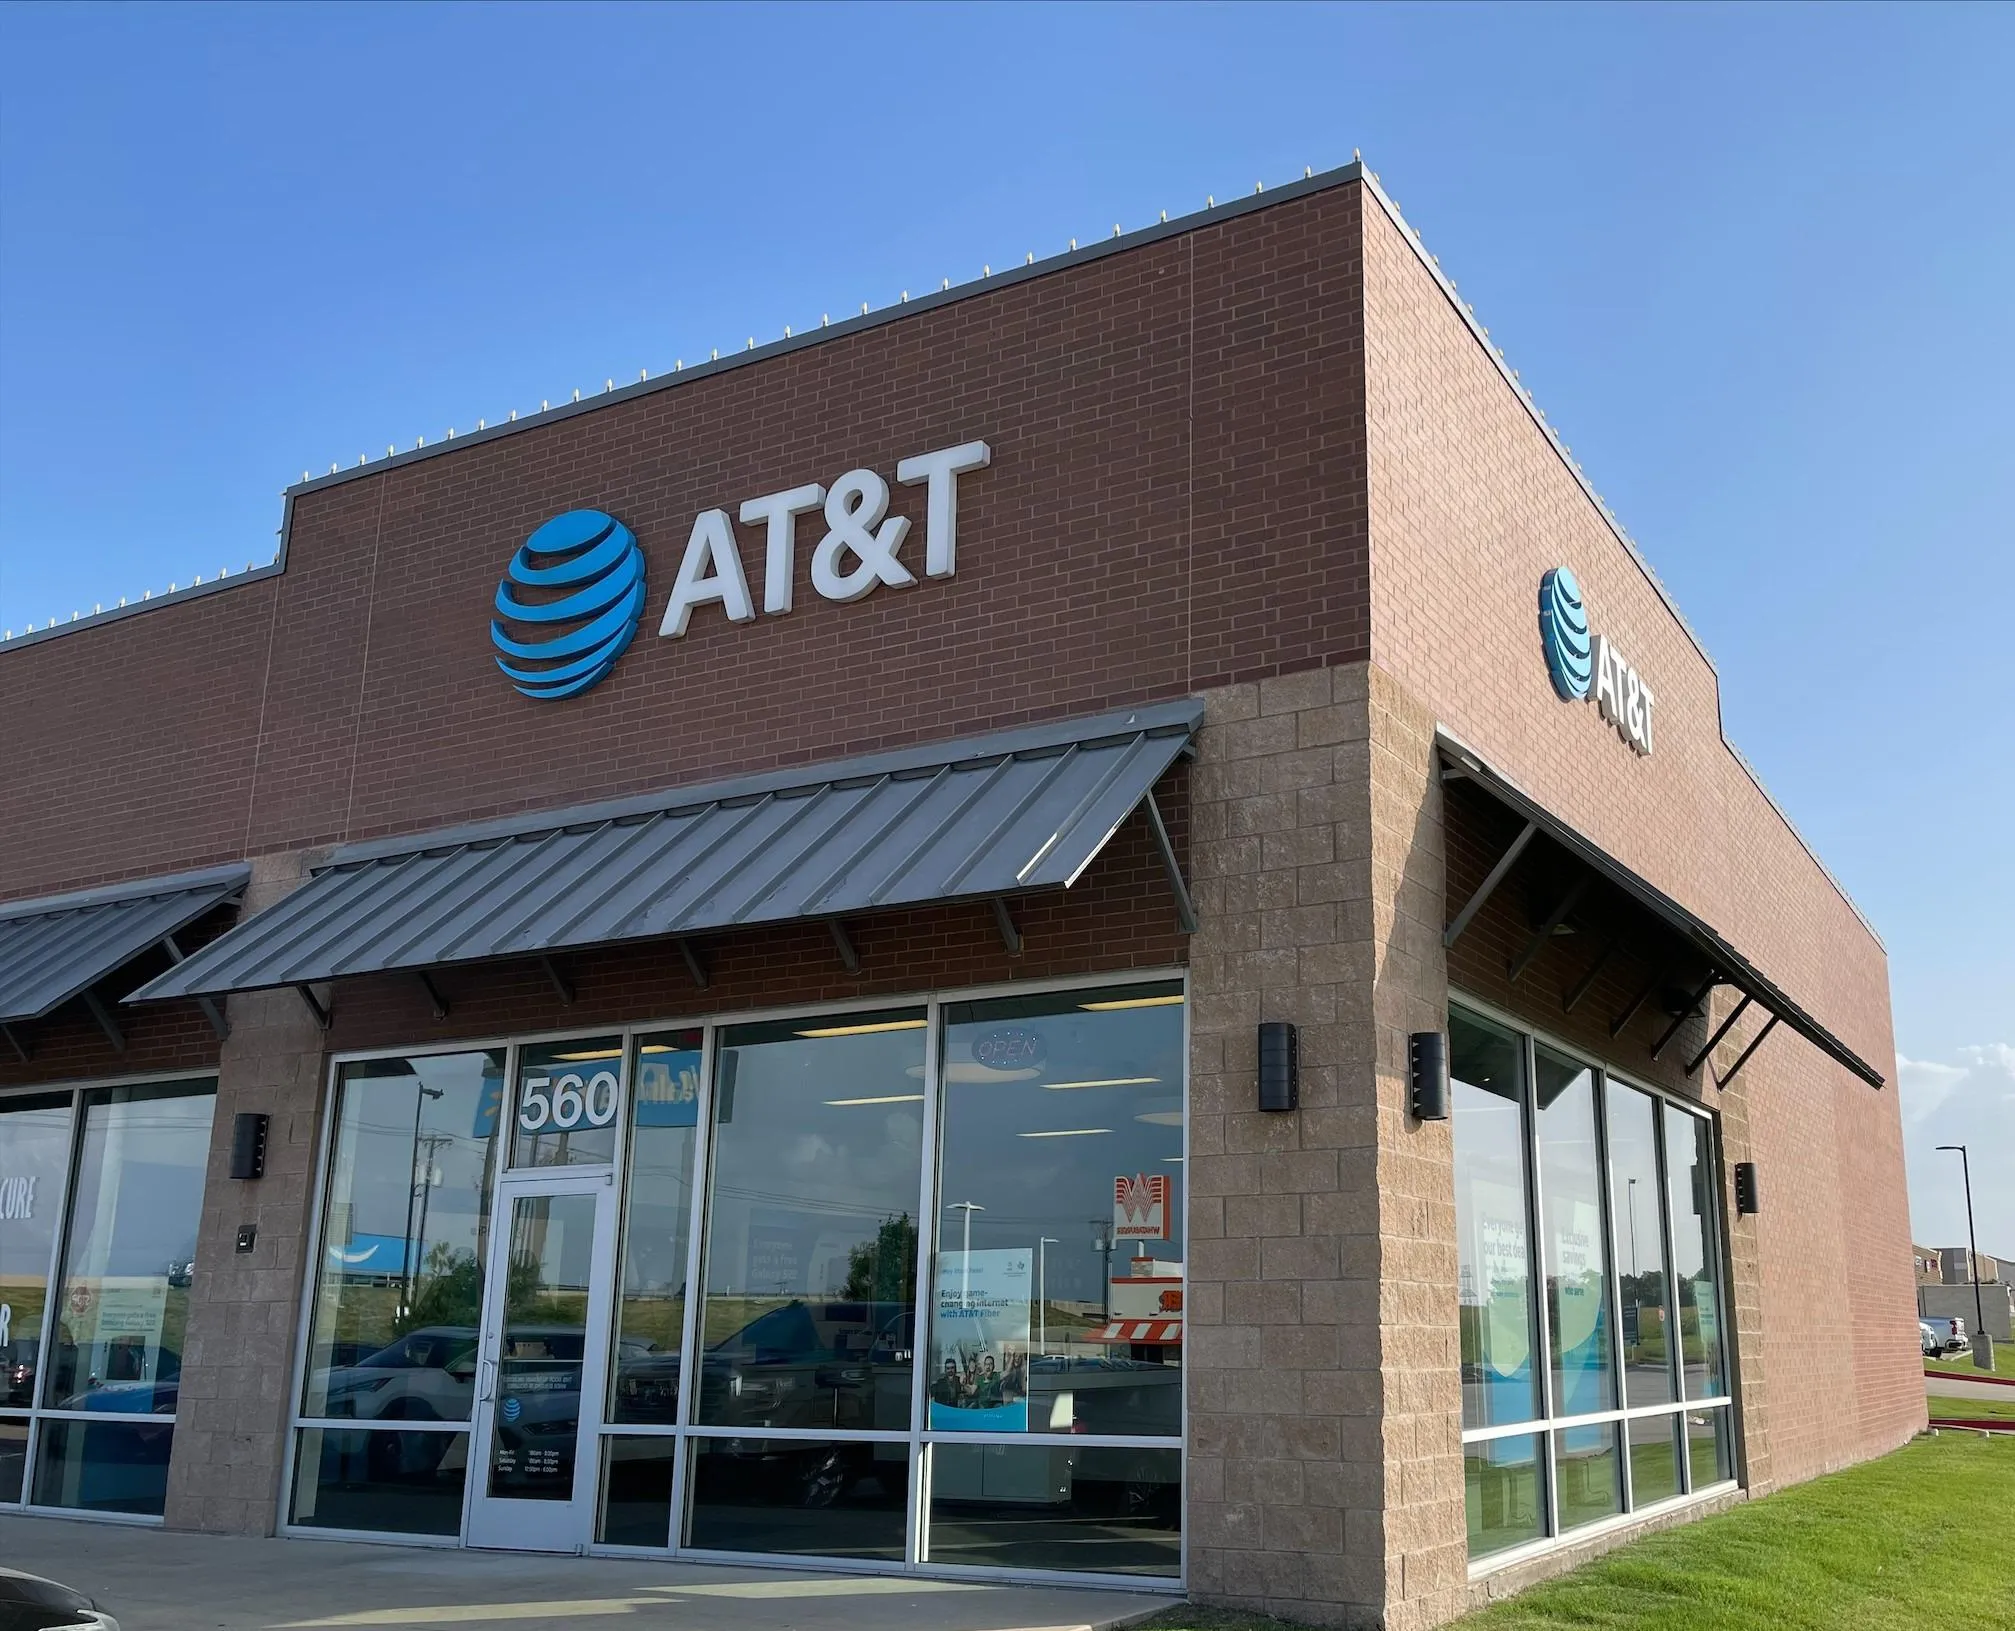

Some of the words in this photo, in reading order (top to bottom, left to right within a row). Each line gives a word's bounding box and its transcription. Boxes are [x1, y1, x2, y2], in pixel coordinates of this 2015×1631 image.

[658, 440, 991, 640] AT&T
[1592, 634, 1655, 756] AT&T
[979, 1040, 1037, 1058] OPEN
[519, 1071, 618, 1130] 560
[1484, 1242, 1495, 1255] our
[1497, 1238, 1512, 1257] best
[941, 1289, 961, 1299] Enjoy
[940, 1299, 975, 1309] changng
[977, 1299, 1008, 1307] internet
[940, 1309, 957, 1318] with
[958, 1309, 978, 1318] AT&T
